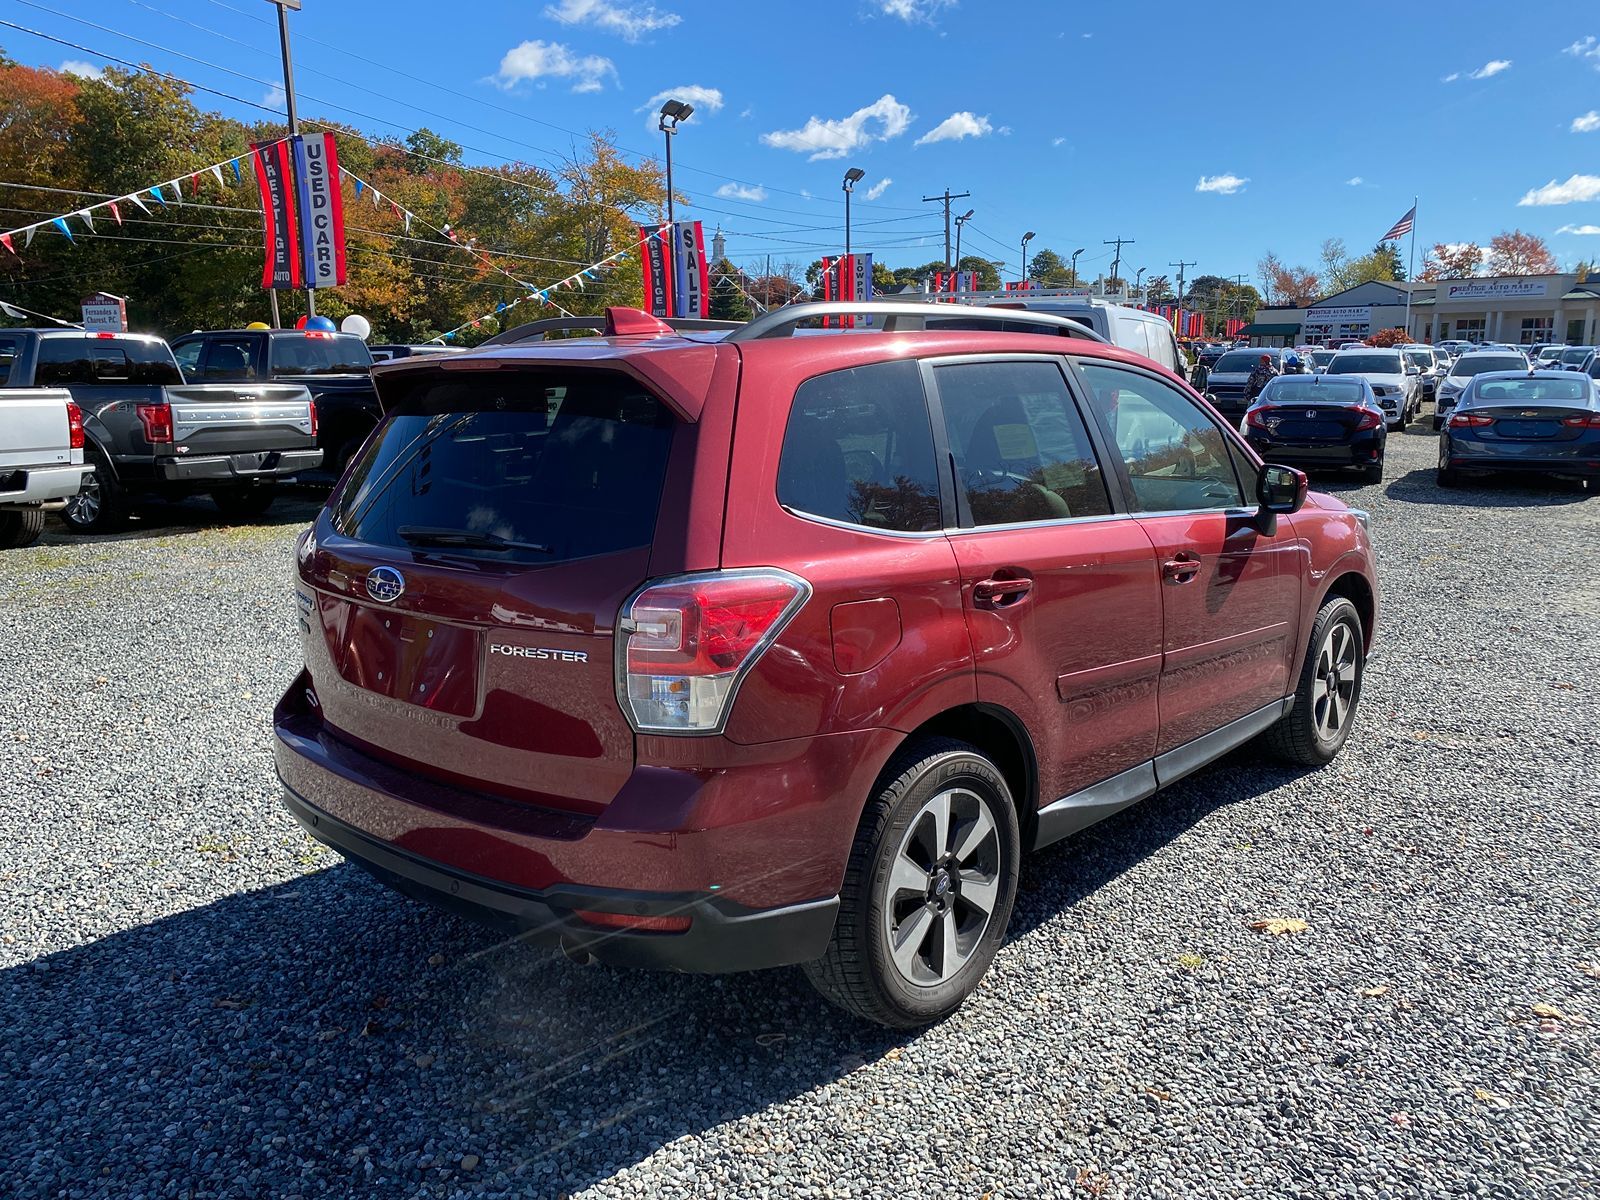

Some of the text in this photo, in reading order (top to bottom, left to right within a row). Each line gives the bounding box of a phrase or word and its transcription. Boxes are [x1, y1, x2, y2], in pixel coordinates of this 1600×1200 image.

[307, 143, 331, 277] USED CARS
[274, 271, 290, 281] AUTO
[683, 229, 698, 313] SALE
[856, 259, 865, 279] LOW
[1449, 284, 1486, 296] PRESTIGE
[490, 643, 588, 663] FORESTER
